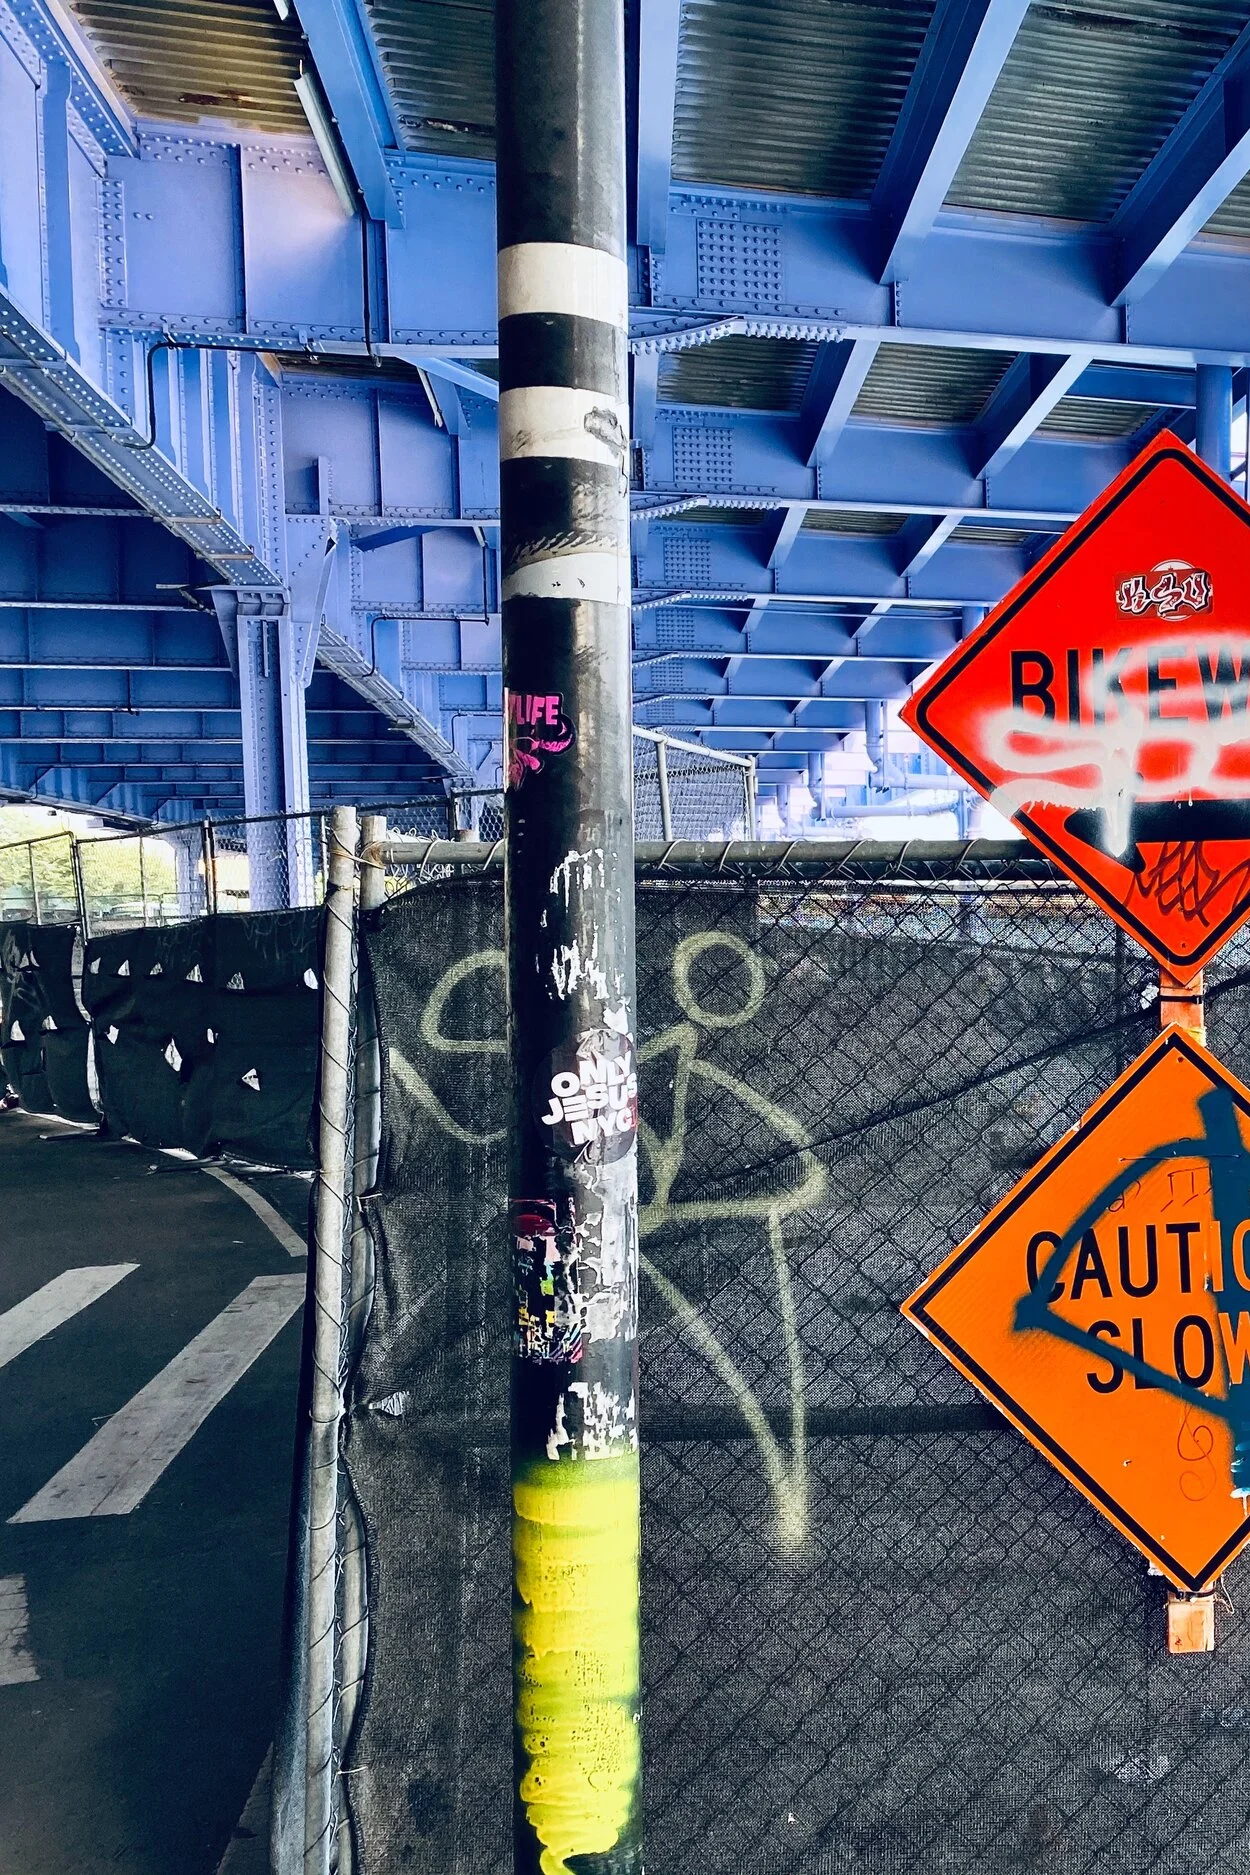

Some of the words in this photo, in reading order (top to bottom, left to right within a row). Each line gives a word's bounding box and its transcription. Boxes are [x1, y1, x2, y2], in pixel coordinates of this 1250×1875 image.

[551, 1050, 632, 1097] ONLY
[541, 1073, 638, 1125] JESUS
[571, 1107, 633, 1146] NYC
